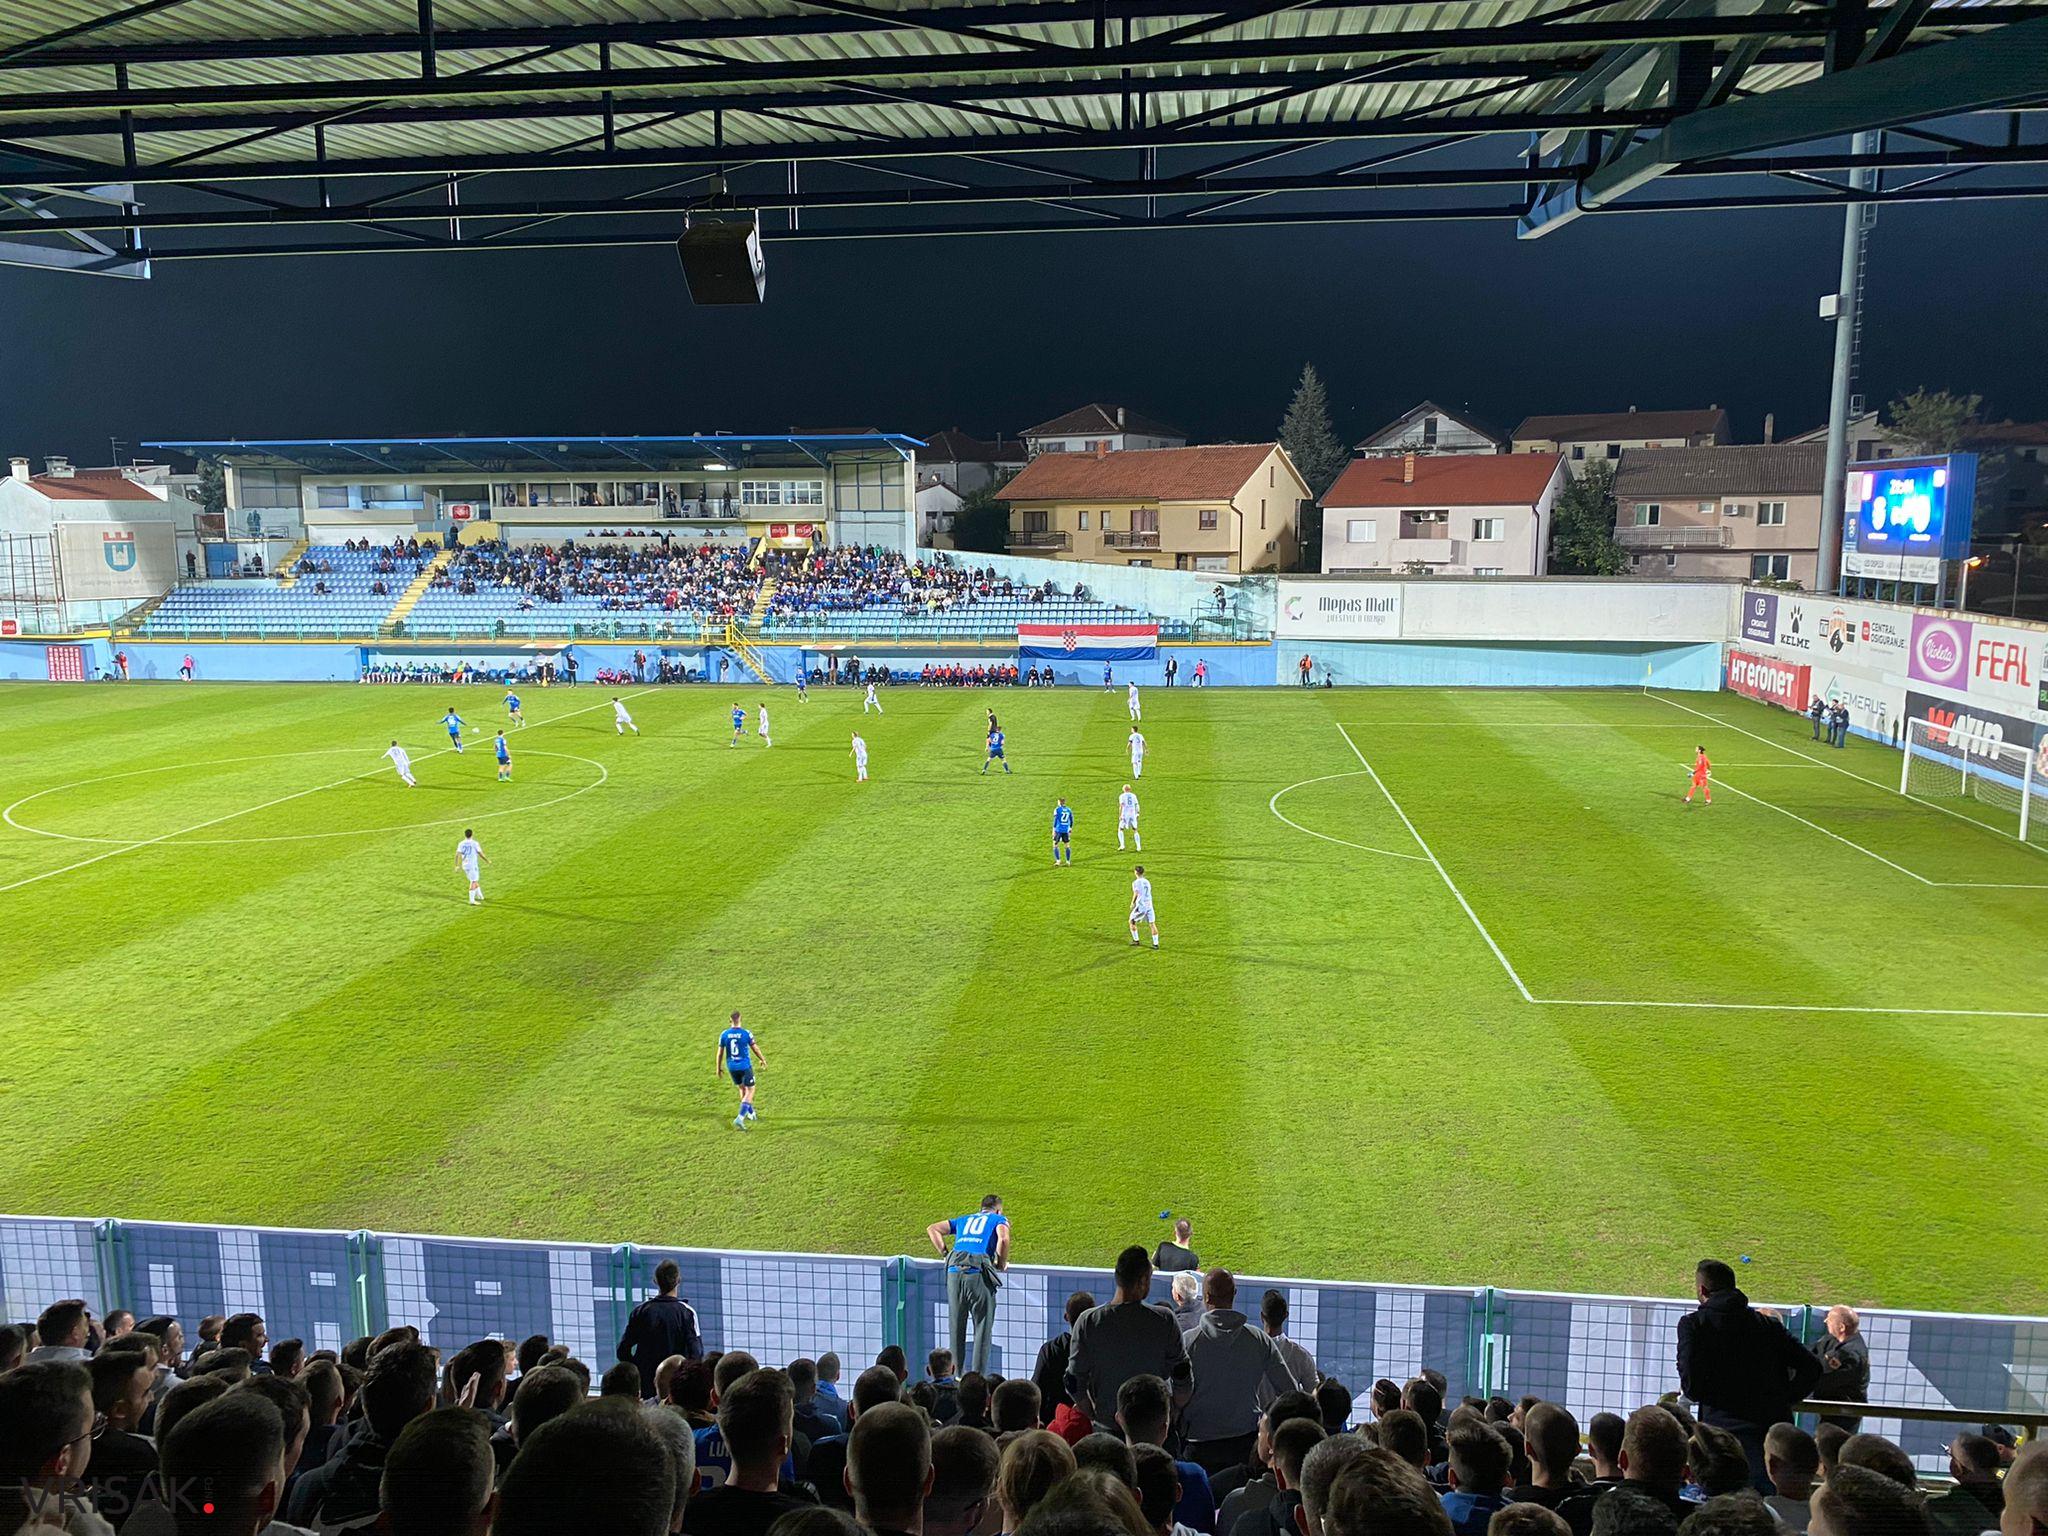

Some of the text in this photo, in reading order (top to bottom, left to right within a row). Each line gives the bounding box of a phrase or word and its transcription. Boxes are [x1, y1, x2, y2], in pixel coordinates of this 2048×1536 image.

[1319, 597, 1394, 614] Mepas Mall
[1871, 622, 1896, 635] CENTRAL
[1780, 633, 1810, 650] KELME
[1870, 632, 1905, 649] OSIGURANJE
[1925, 637, 1954, 663] Violeta
[1731, 658, 1747, 684] HT
[1975, 639, 2031, 688] FEAL
[1842, 691, 1887, 716] EMERUS
[730, 1039, 739, 1056] 6
[962, 1215, 989, 1235] 10
